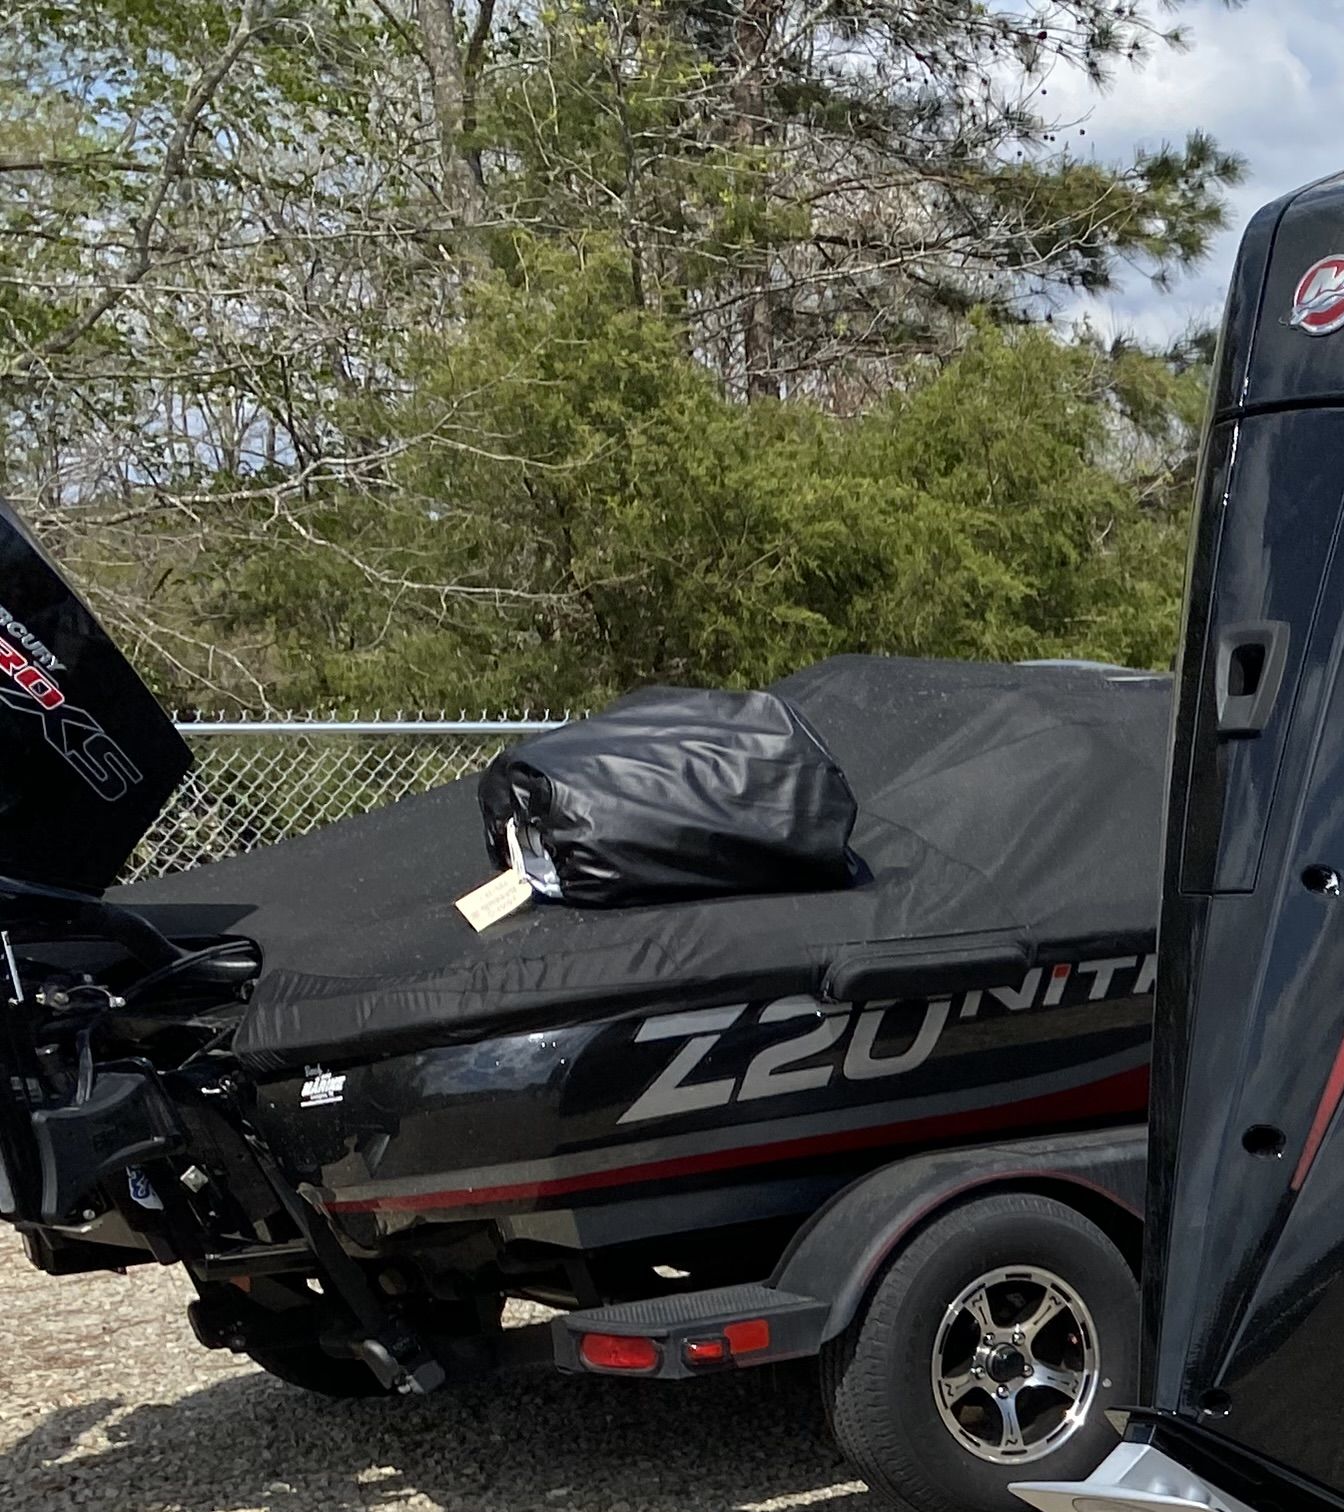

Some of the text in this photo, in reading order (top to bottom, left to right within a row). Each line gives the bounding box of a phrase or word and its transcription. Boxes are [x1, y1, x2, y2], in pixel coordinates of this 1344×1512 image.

[0, 604, 68, 672] RCURY
[0, 636, 65, 710] RO
[616, 994, 952, 1126] Z20
